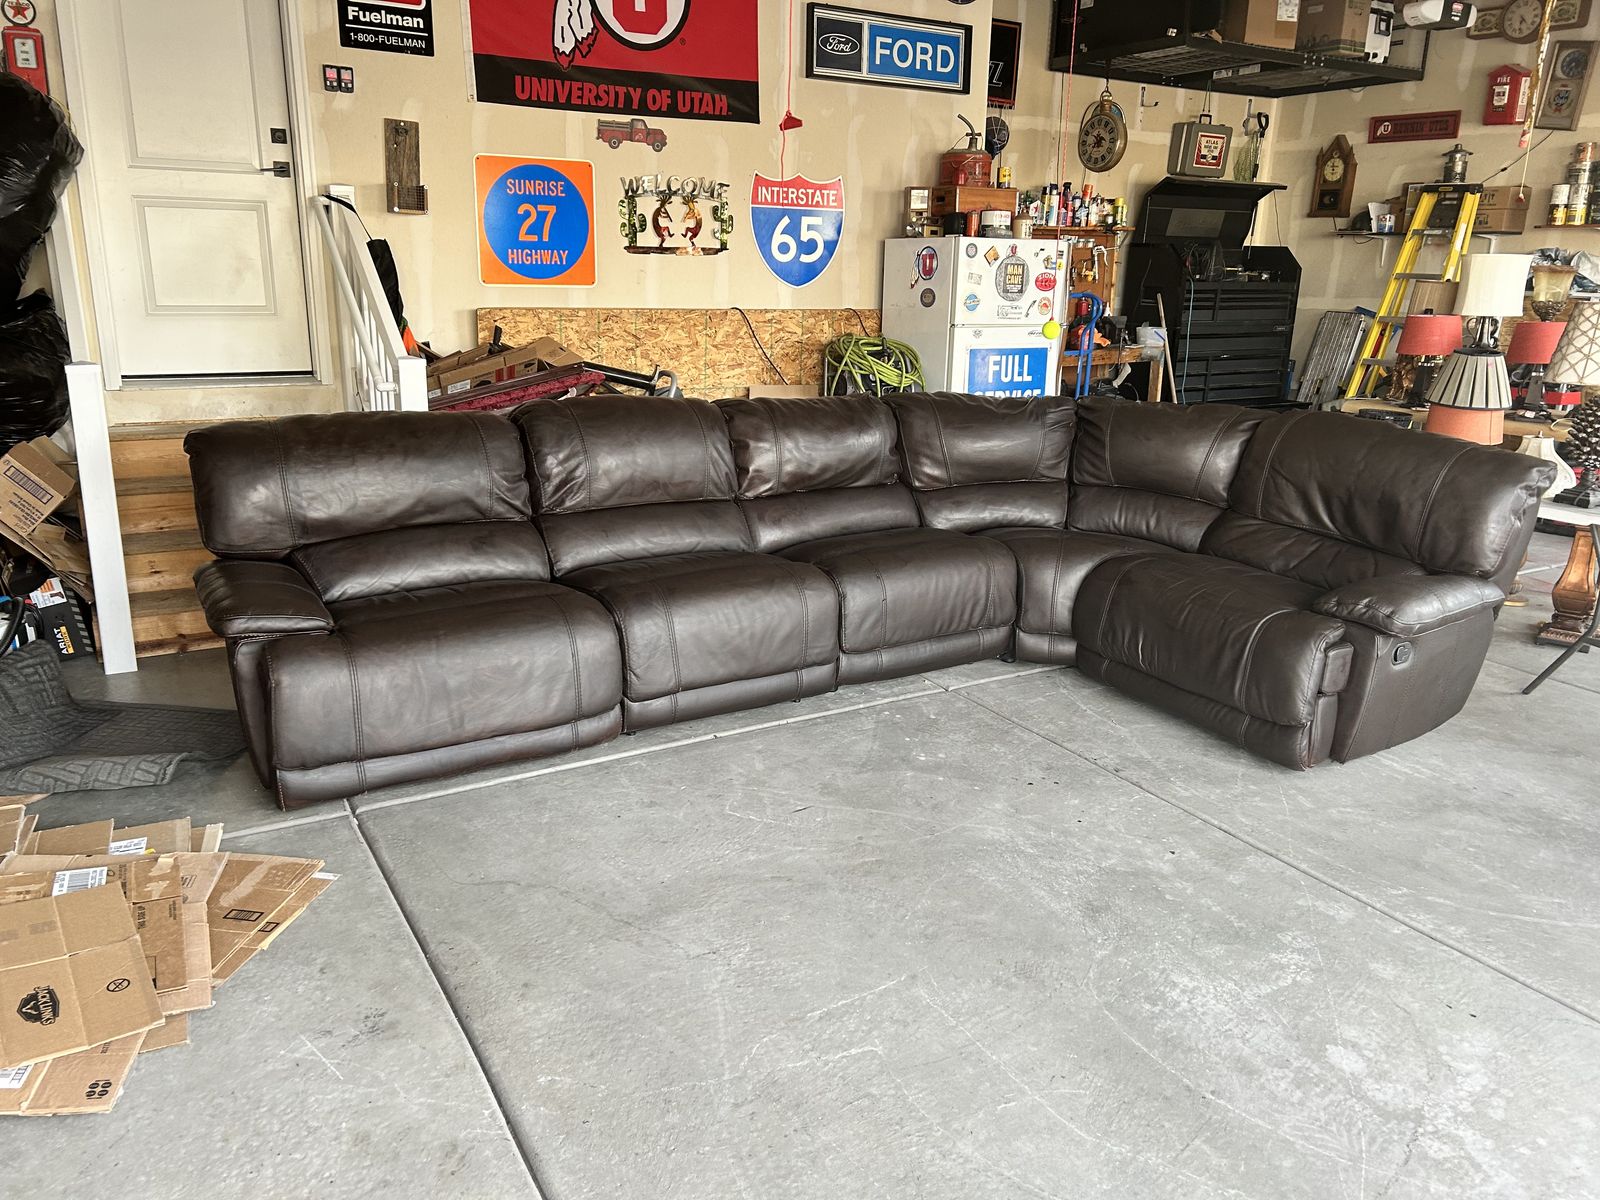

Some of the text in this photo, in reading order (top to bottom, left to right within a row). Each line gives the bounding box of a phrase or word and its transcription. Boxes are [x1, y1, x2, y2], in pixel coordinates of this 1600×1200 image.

[347, 6, 425, 29] Fuelman
[349, 32, 426, 48] 1-800-FUELMAN
[826, 34, 852, 52] Ford
[875, 36, 955, 73] FORD
[514, 75, 729, 116] UNIVERSITY OF UTAH
[506, 178, 566, 197] SUNRISE
[620, 174, 730, 199] WELCOME
[758, 186, 838, 206] INTERSTATE
[517, 203, 557, 242] 27
[771, 215, 825, 263] 65
[508, 249, 569, 265] HIGHWAY
[922, 253, 935, 277] U
[1006, 275, 1023, 285] CAVE
[1007, 264, 1024, 275] MAN
[988, 354, 1032, 383] FULL
[53, 628, 69, 654] ARIAT
